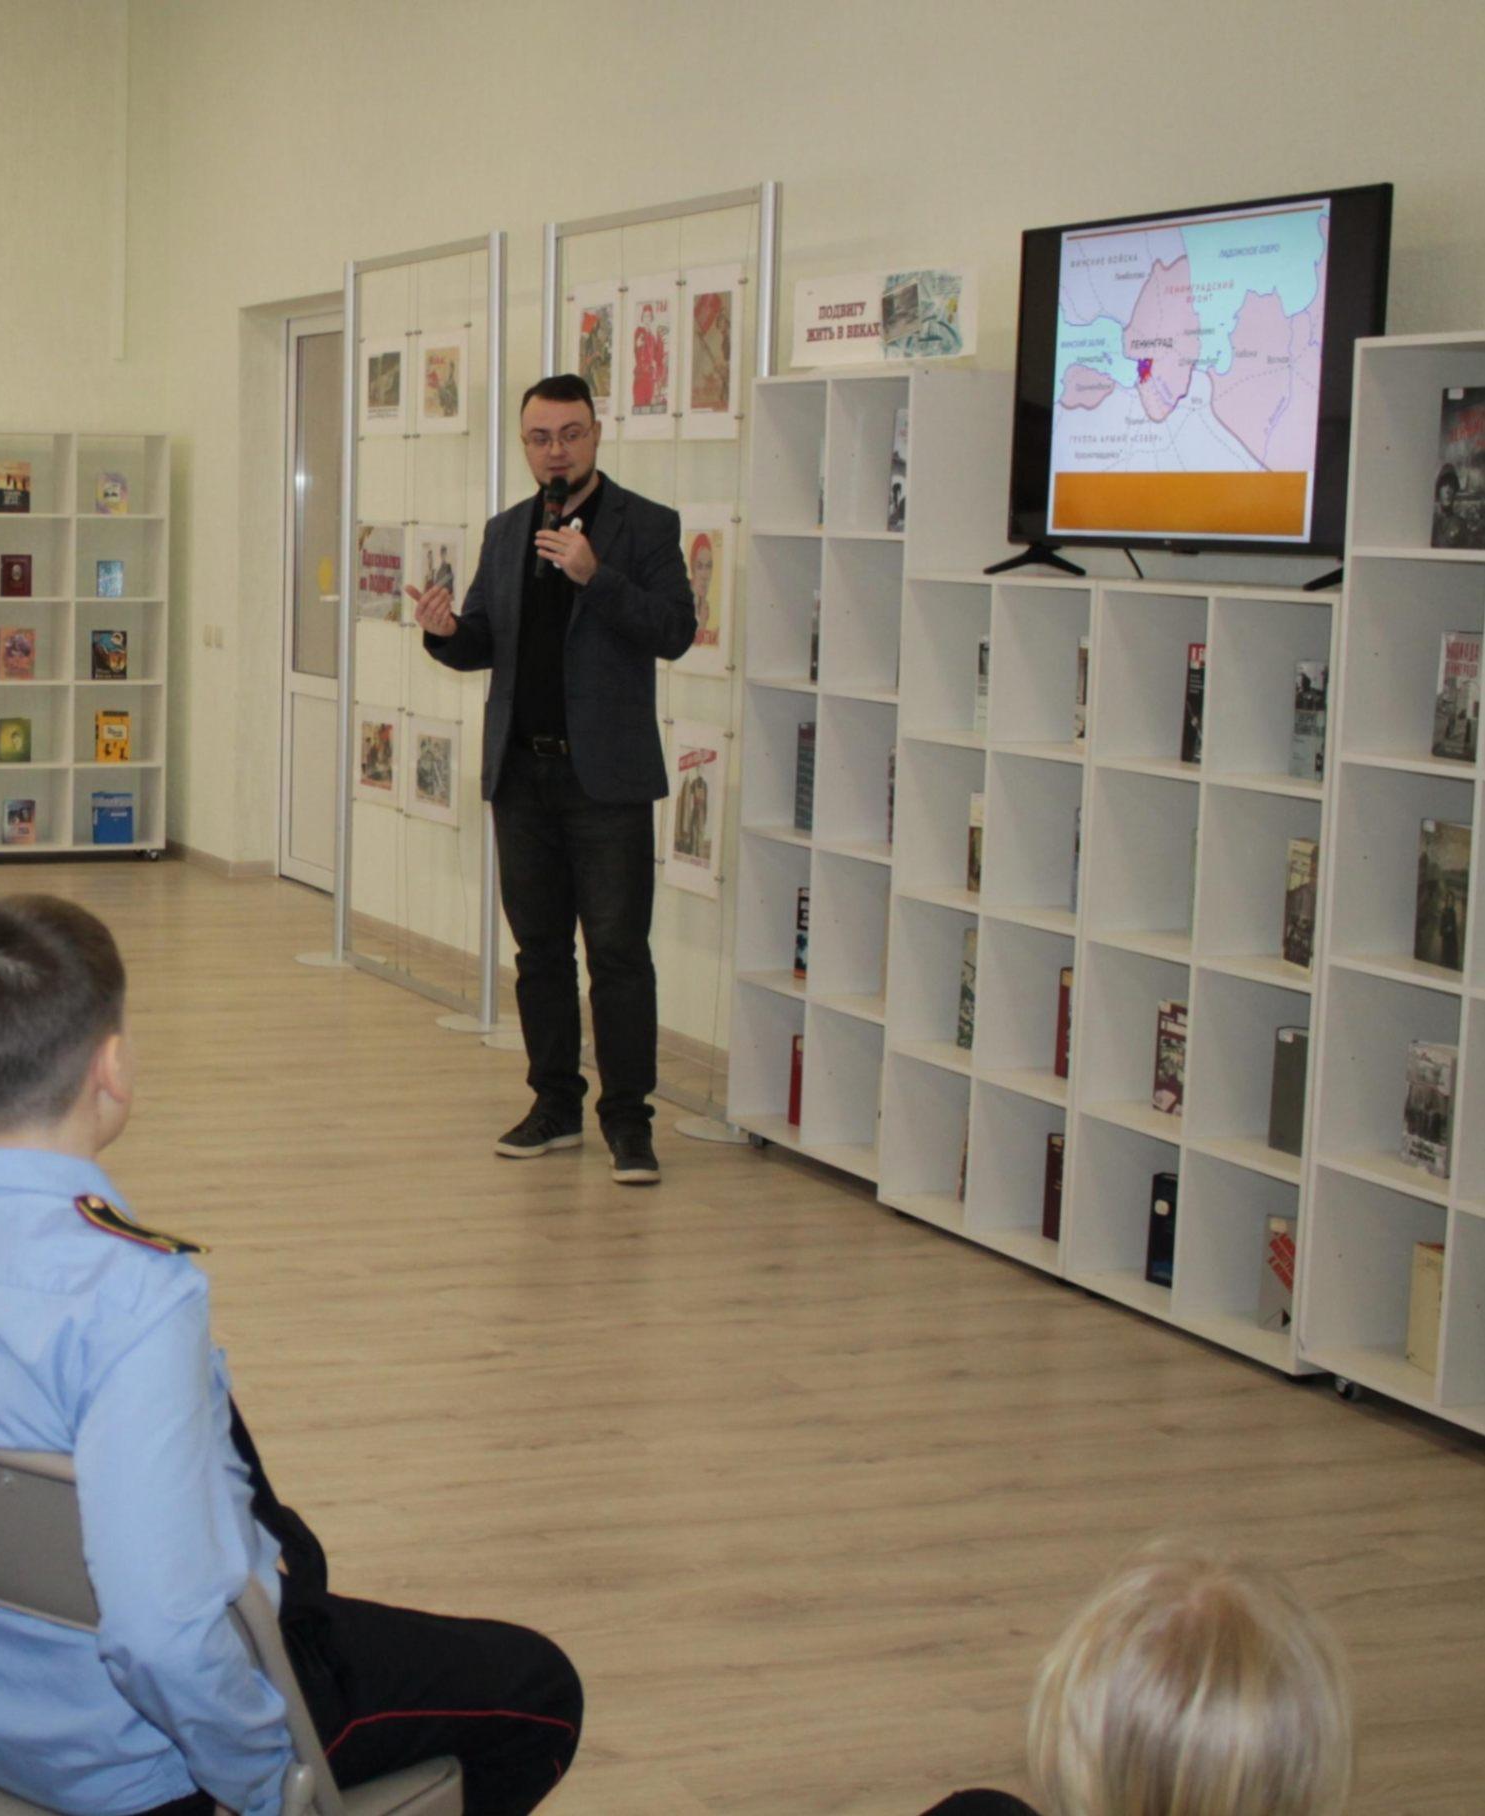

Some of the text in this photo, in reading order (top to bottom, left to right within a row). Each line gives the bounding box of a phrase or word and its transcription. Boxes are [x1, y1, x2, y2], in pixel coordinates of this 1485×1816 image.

[818, 302, 867, 320] ПОДВИГУ
[806, 322, 880, 342] ЖИТЬ В ВЕКАХ
[1131, 337, 1173, 350] ЛЕНИНГРАД
